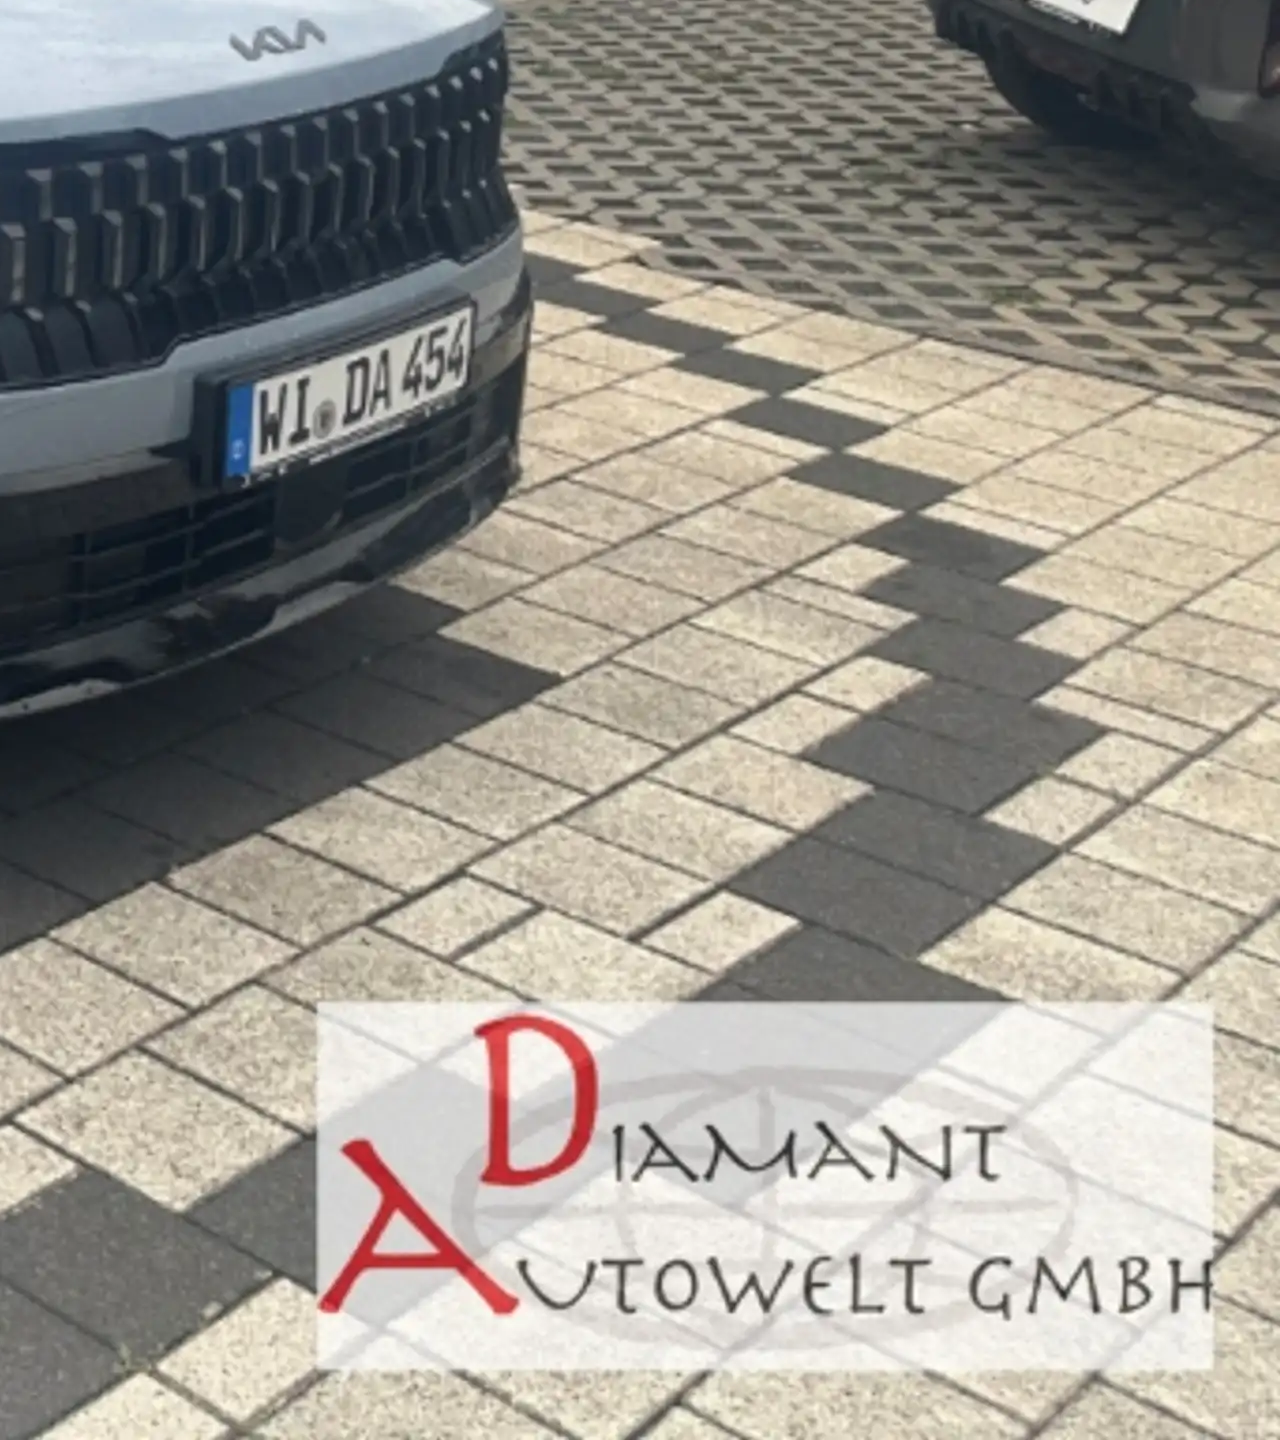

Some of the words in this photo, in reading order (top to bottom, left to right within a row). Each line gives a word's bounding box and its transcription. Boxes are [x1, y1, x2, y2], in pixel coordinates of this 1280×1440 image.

[229, 18, 327, 62] KIA
[259, 376, 311, 456] WI
[342, 348, 392, 426] DA
[401, 316, 468, 400] 454
